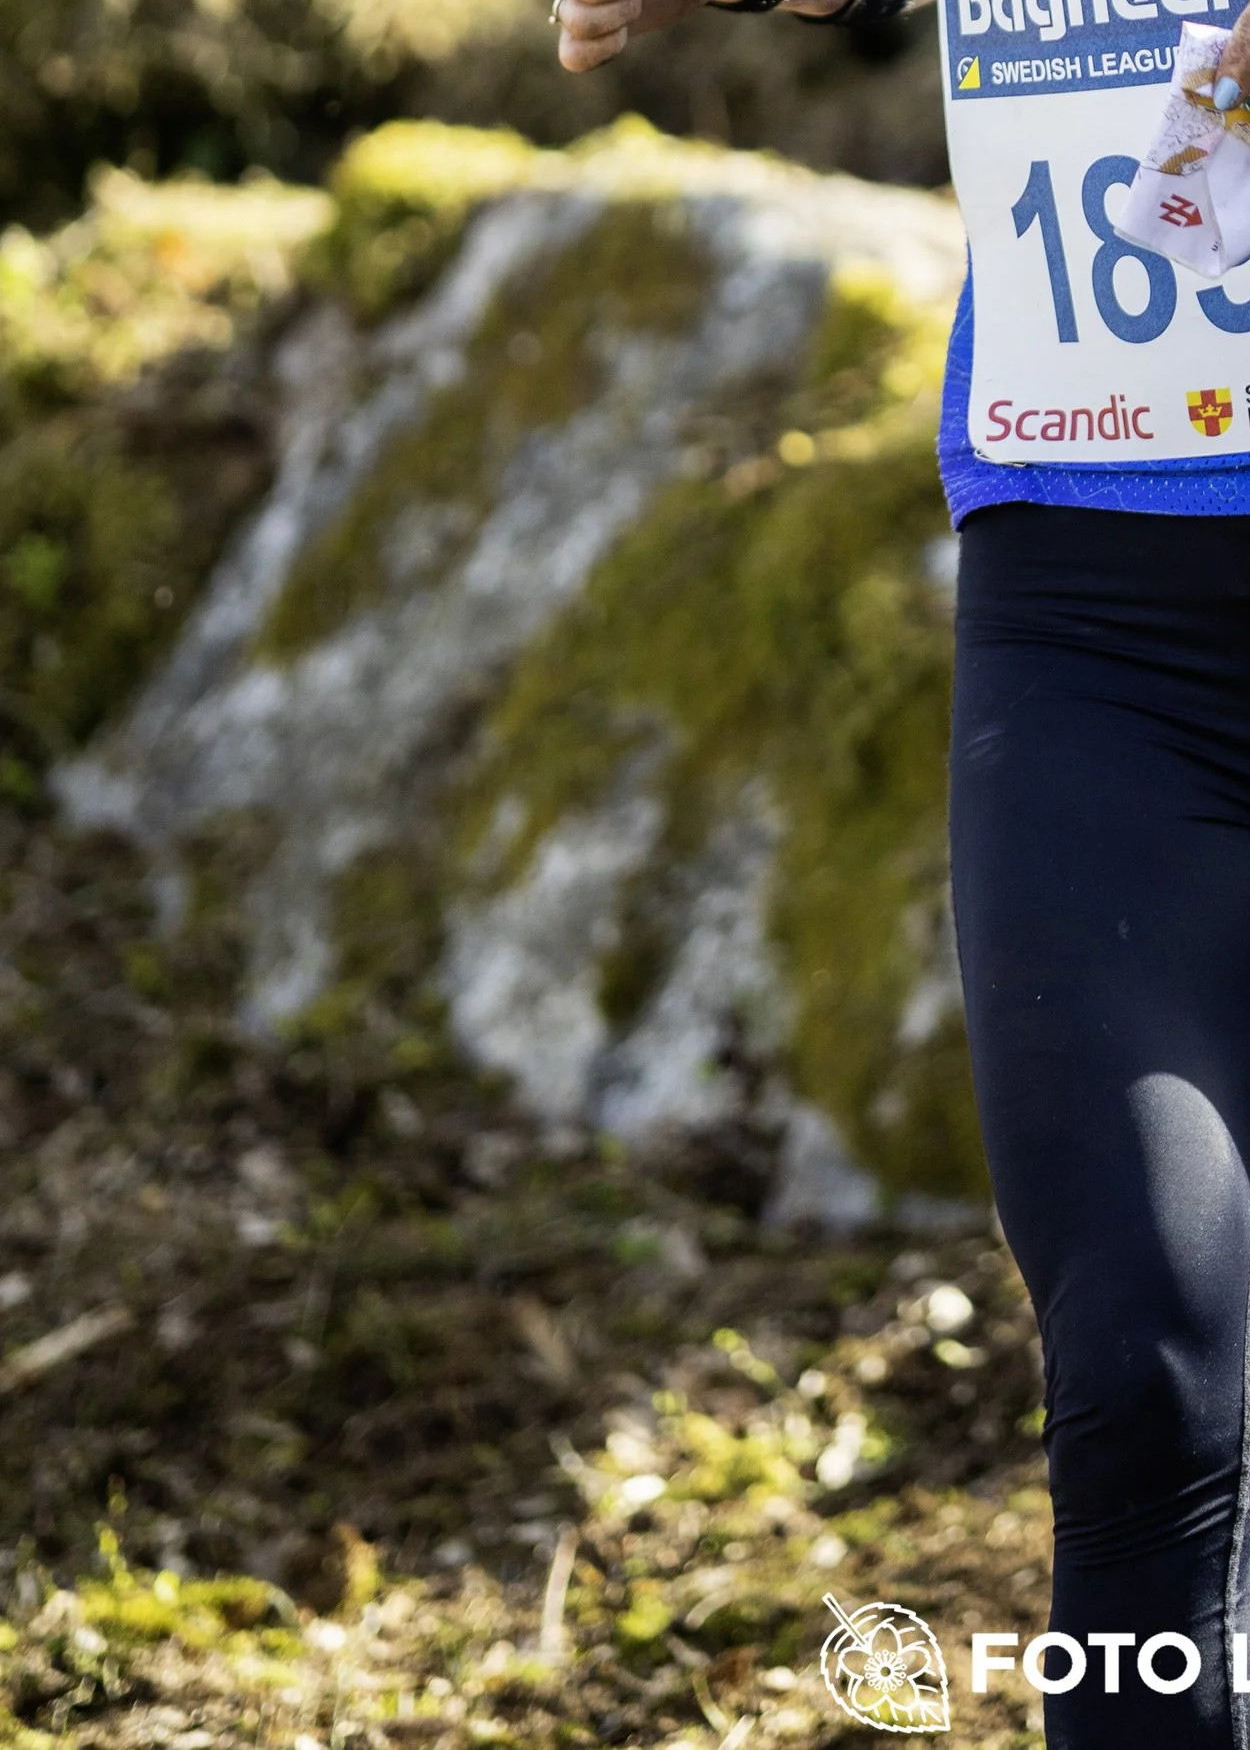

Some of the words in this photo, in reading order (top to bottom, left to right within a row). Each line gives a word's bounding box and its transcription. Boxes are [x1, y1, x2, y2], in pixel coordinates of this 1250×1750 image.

[991, 56, 1082, 85] SWEDISH
[1087, 47, 1180, 78] LEAGU
[986, 394, 1154, 442] Scandic
